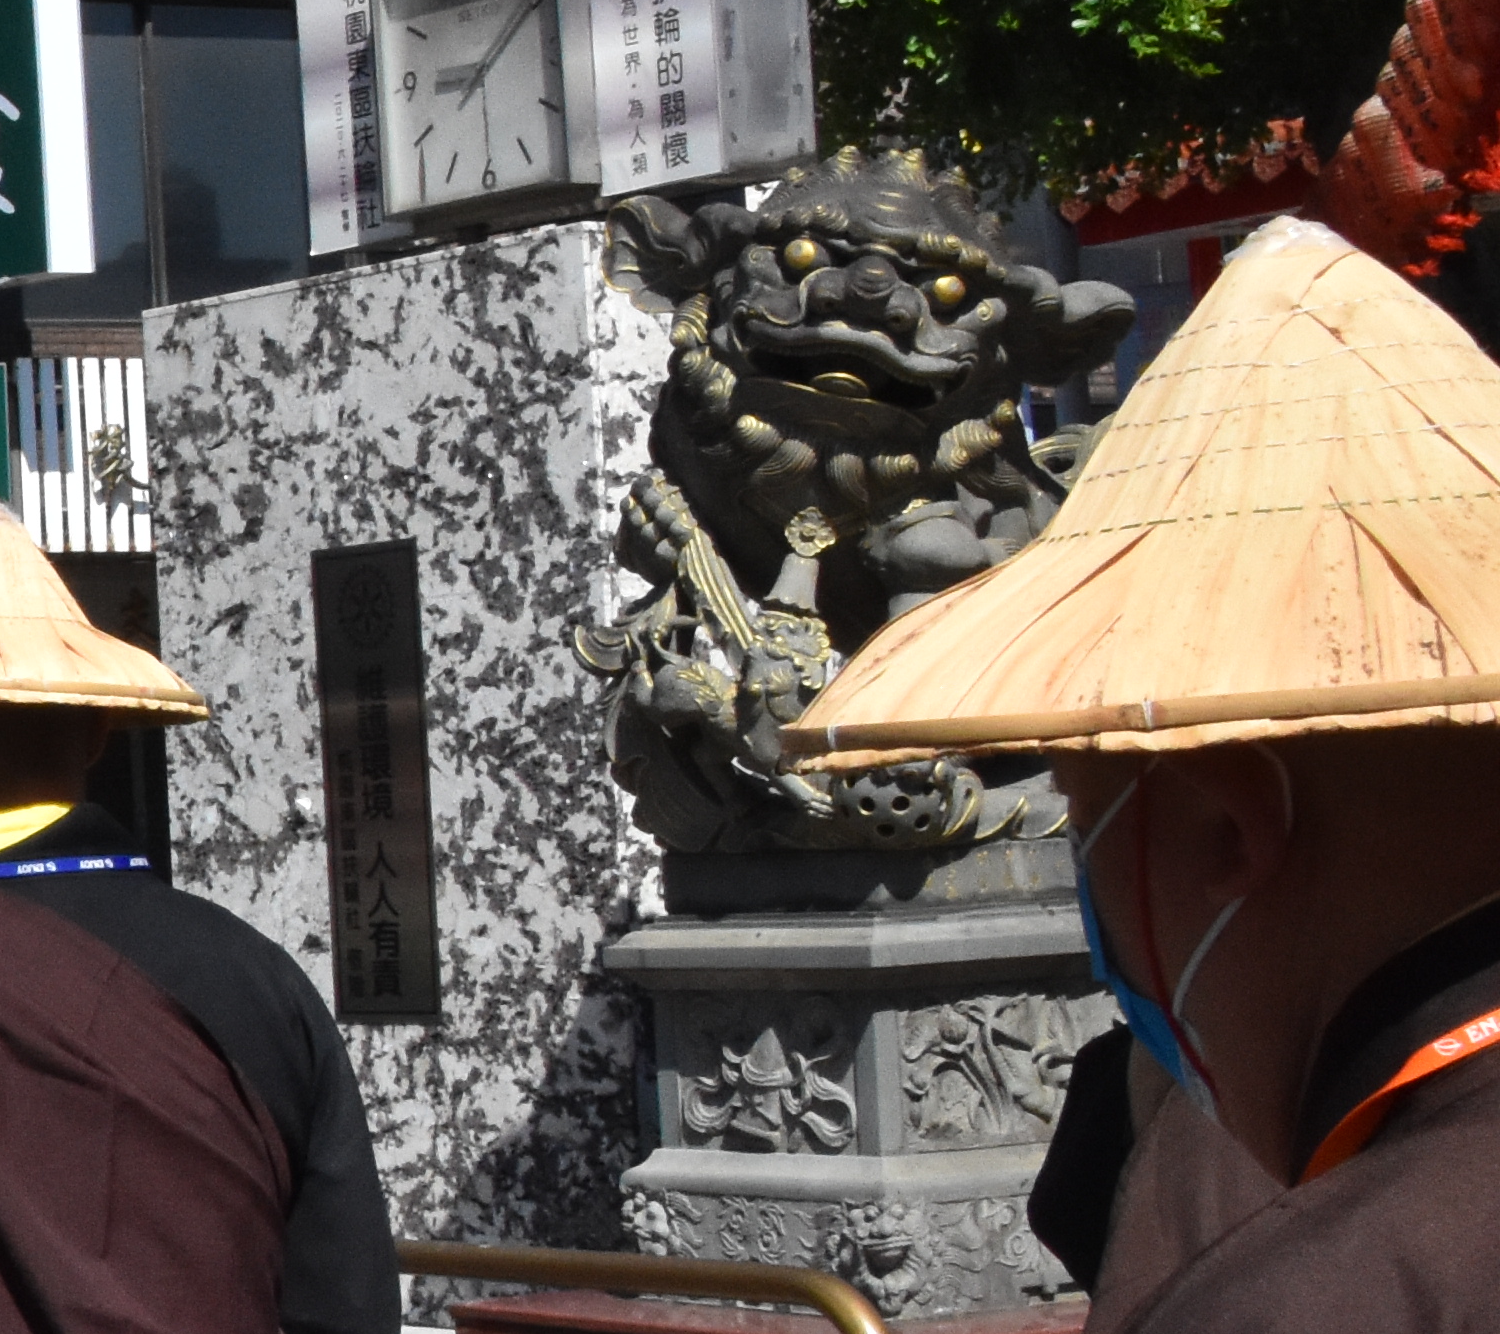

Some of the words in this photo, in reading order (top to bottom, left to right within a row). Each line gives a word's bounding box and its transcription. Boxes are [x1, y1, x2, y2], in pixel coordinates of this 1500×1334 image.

[402, 71, 417, 103] 9
[480, 158, 496, 189] 6
[366, 841, 402, 998] 人人有責
